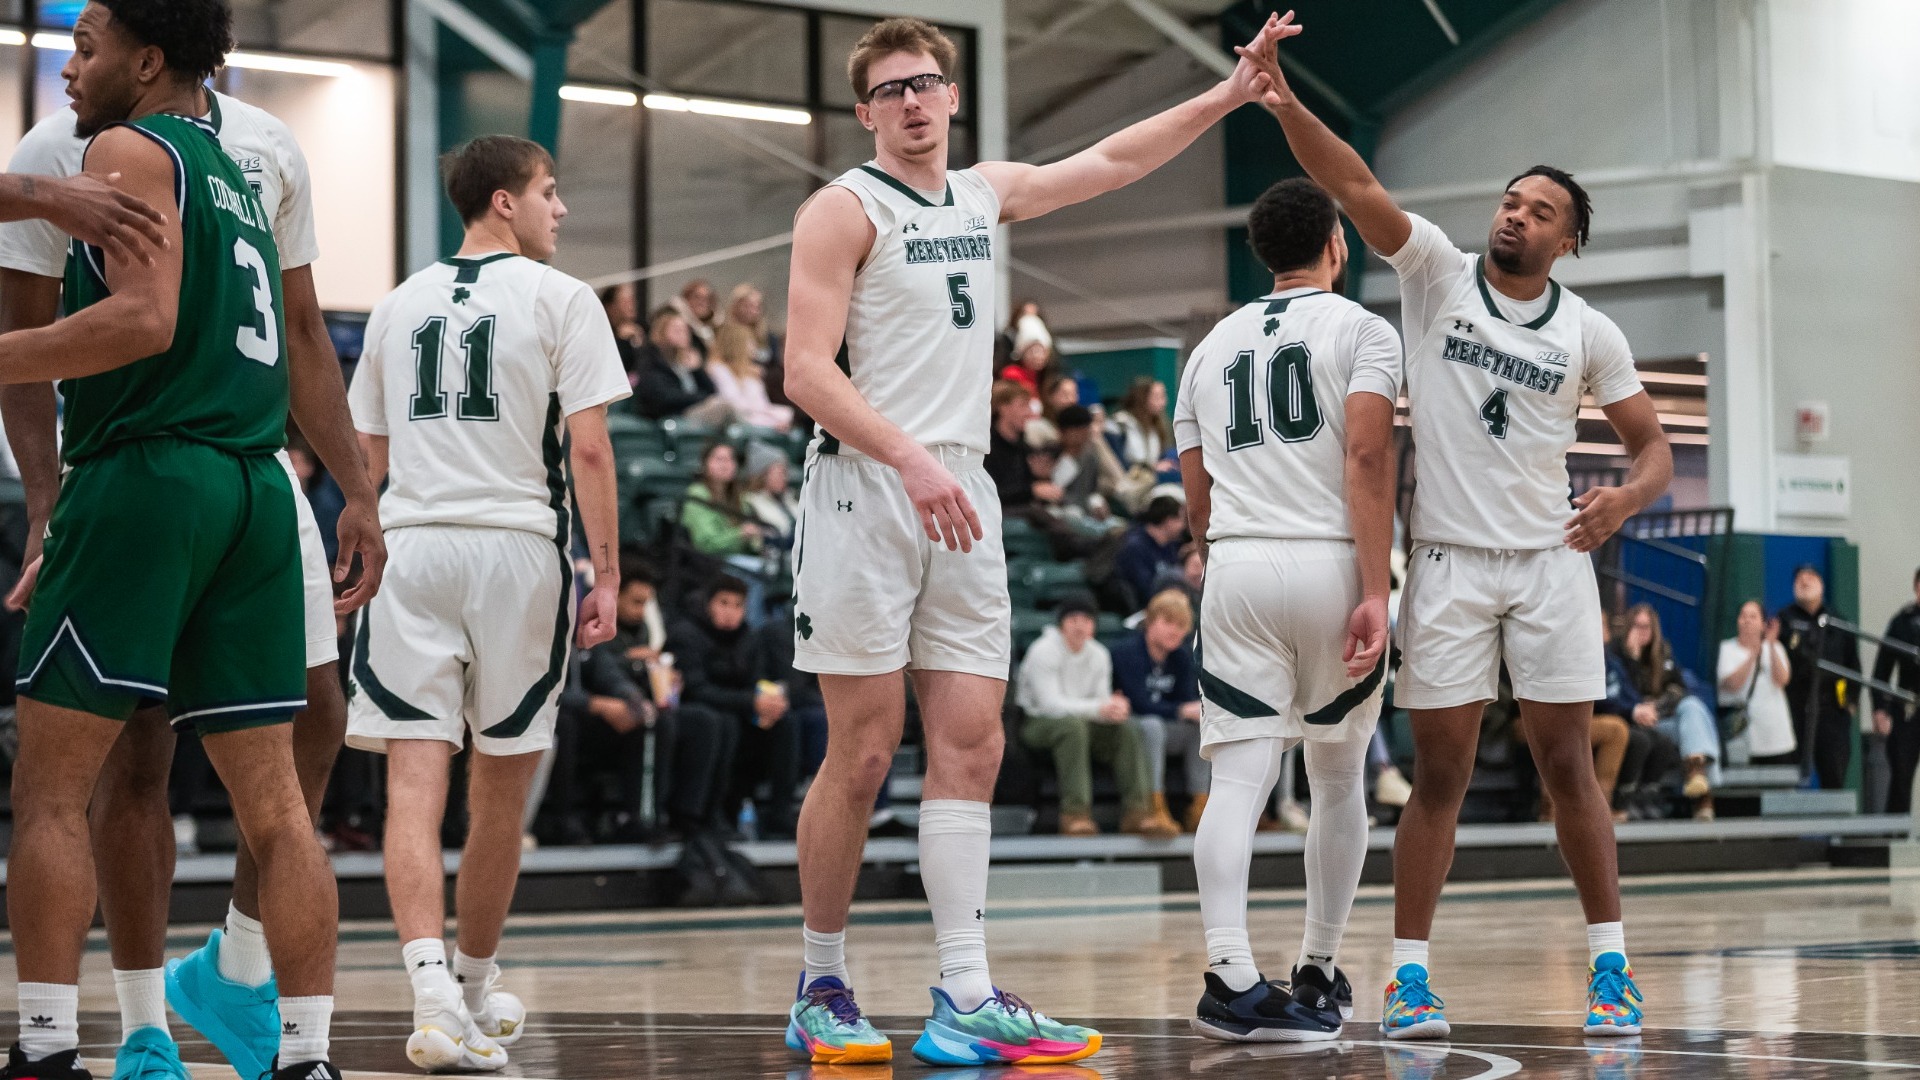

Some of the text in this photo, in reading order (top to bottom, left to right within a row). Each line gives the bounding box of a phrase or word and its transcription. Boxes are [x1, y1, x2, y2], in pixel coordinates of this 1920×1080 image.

[903, 235, 992, 264] MERCYHURST
[964, 215, 985, 231] NEC
[233, 235, 279, 367] 3
[946, 272, 975, 329] 5
[408, 314, 500, 422] 11
[1442, 335, 1566, 396] MERCYHURST
[1535, 351, 1571, 363] NEC
[1223, 341, 1325, 453] 10
[1479, 387, 1509, 440] 4
